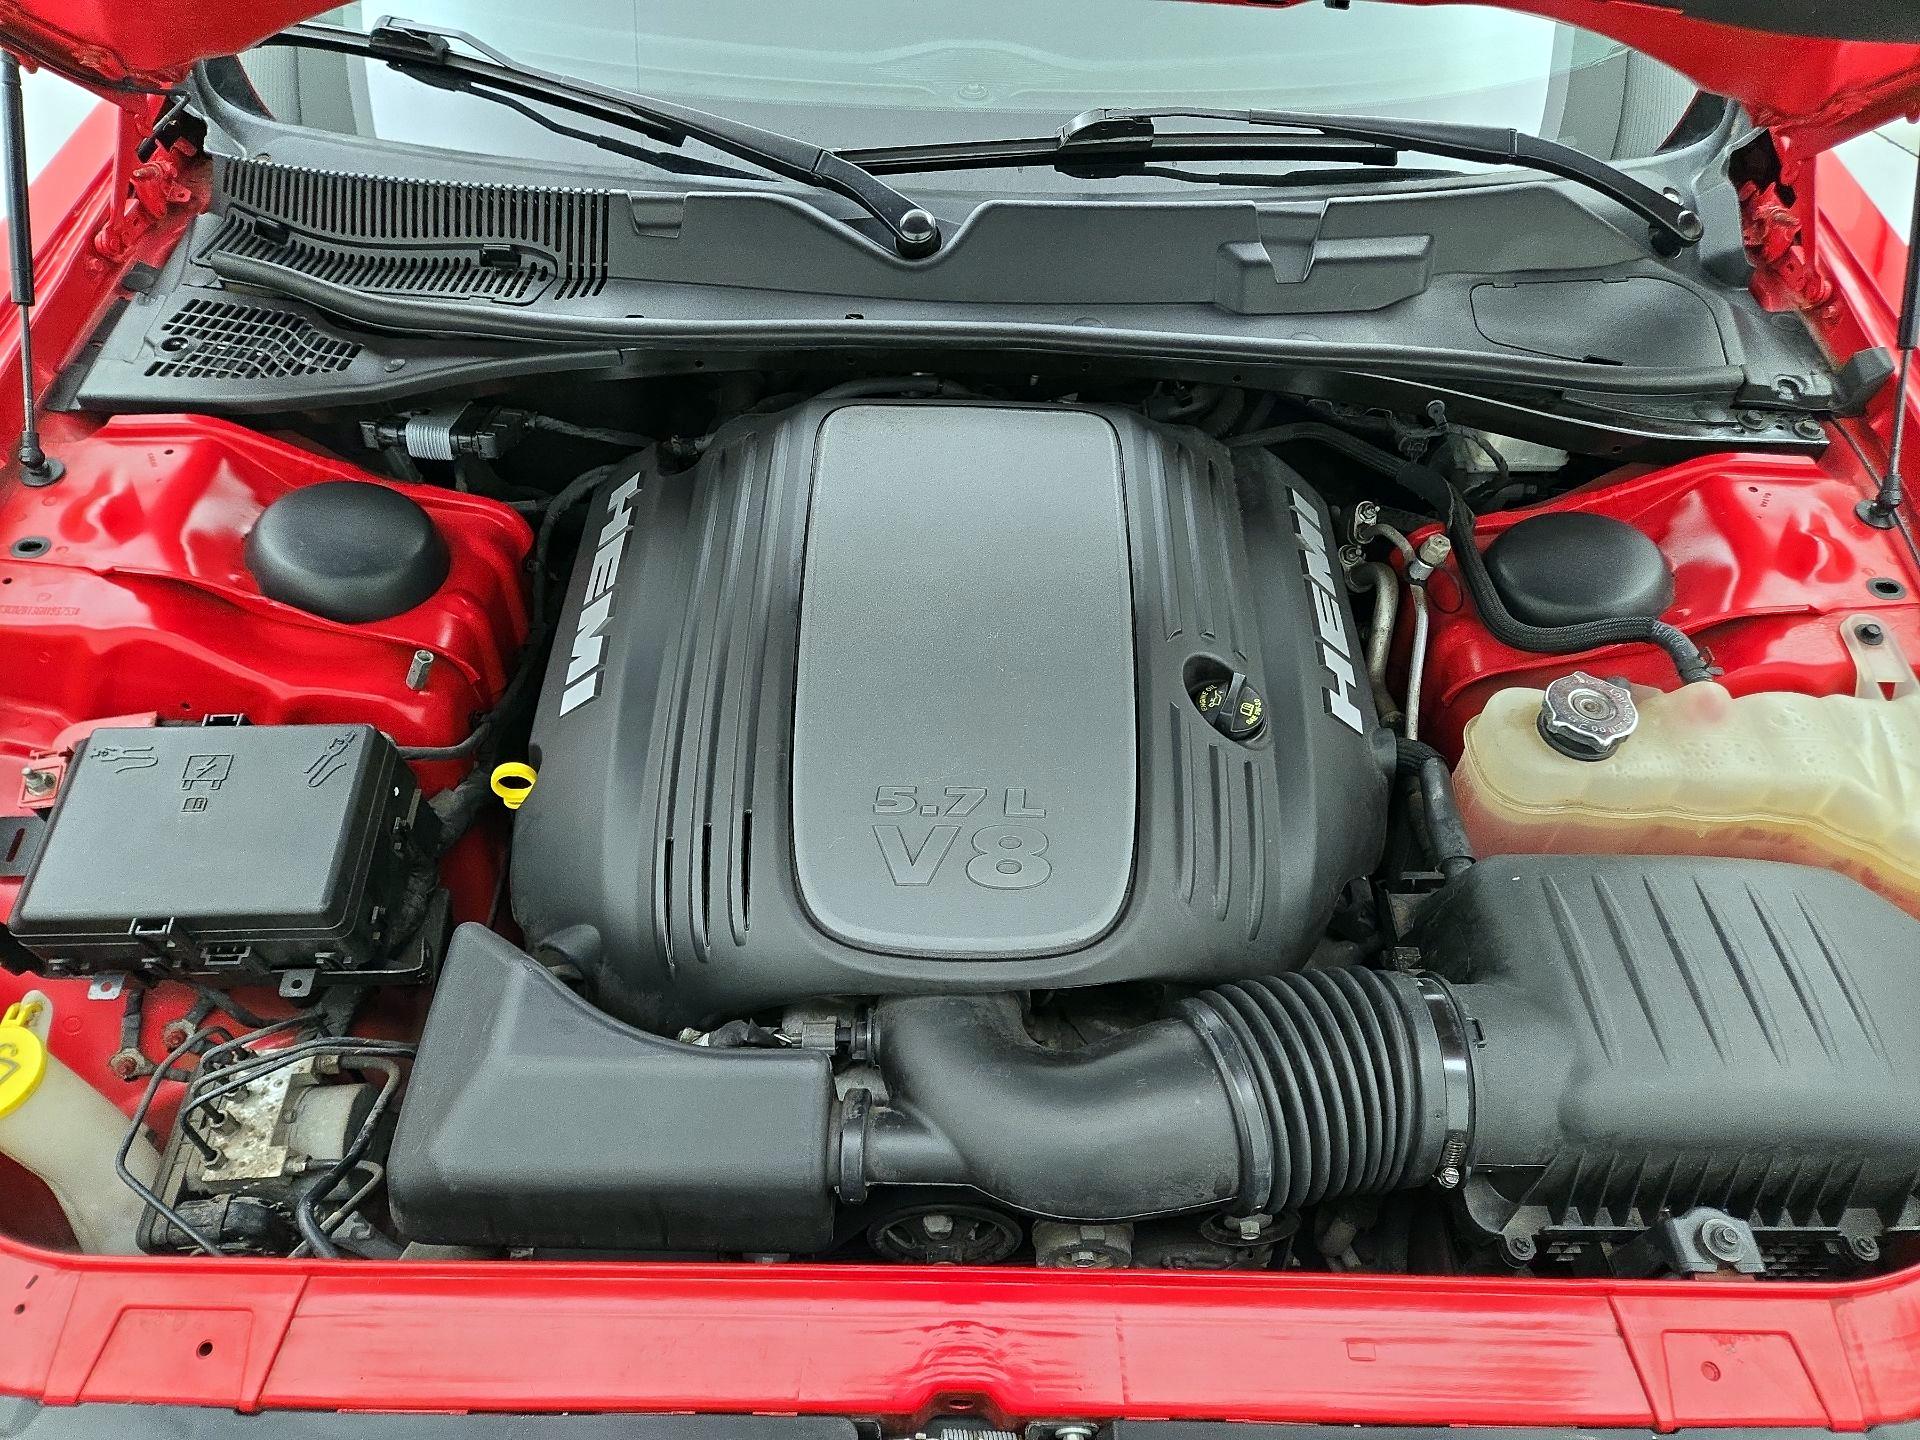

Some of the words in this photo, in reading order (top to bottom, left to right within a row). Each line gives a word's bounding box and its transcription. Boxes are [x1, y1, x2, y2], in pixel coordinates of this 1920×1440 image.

[559, 472, 640, 717] HEMI
[1290, 488, 1364, 734] HEMI
[1199, 691, 1209, 712] ENGINE
[1205, 684, 1218, 692] OIL
[1245, 715, 1259, 725] SAE
[873, 785, 988, 818] 5.7
[1003, 787, 1047, 819] L
[872, 824, 1053, 890] V8
